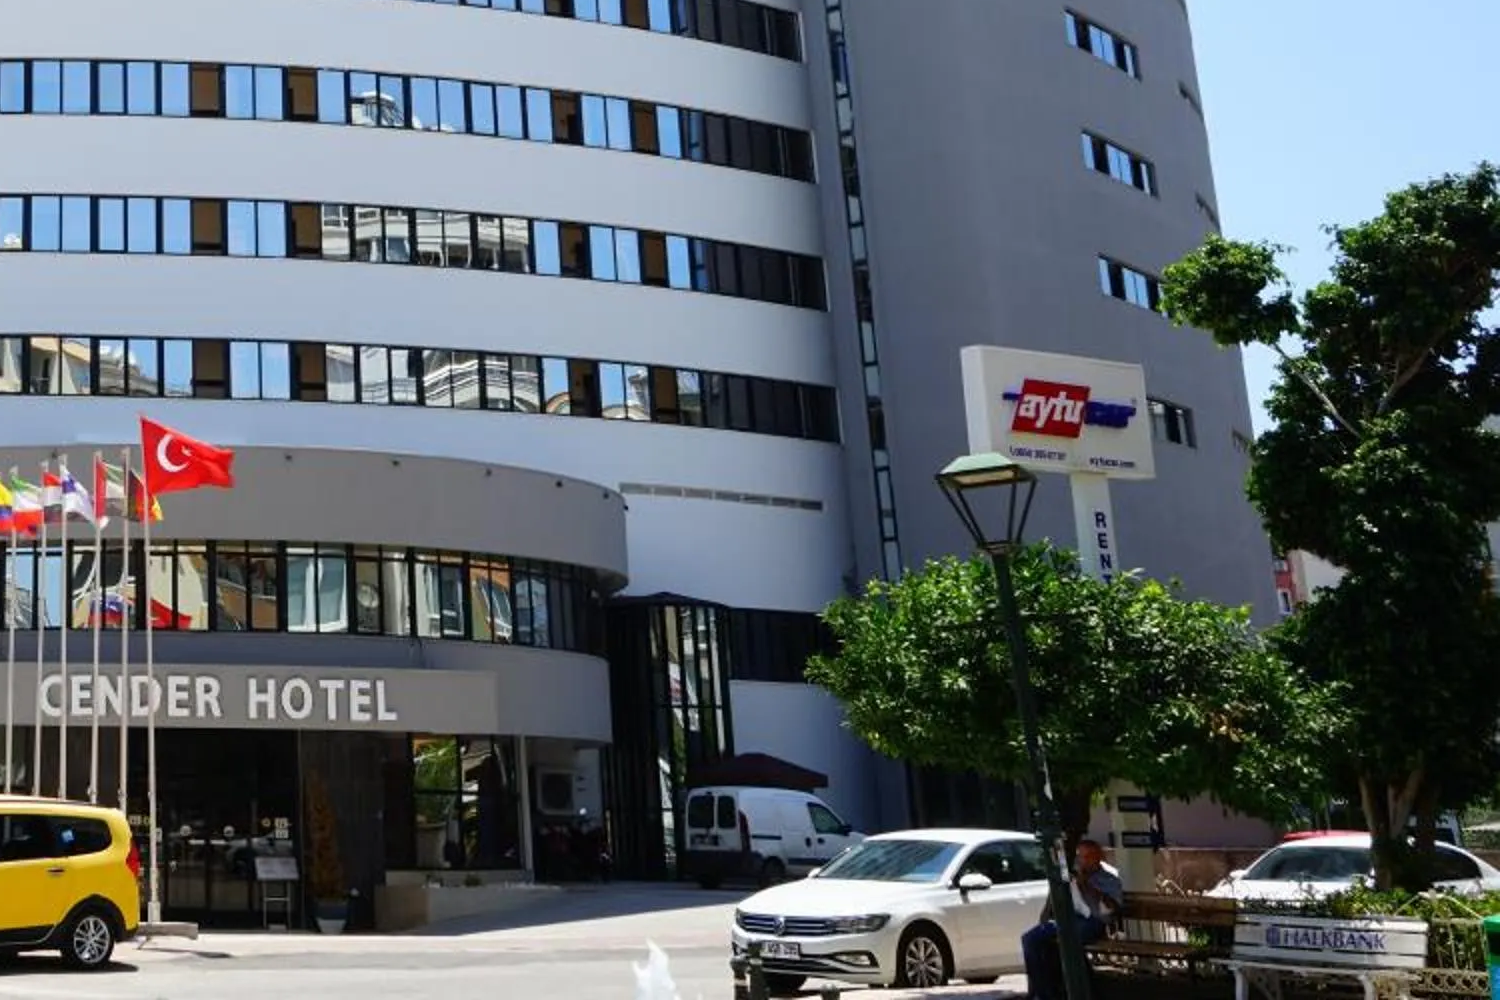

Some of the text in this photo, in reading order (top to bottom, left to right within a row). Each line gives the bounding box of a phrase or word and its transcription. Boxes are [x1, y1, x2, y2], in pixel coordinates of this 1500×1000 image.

[38, 674, 399, 722] CENDER HOTEL
[1284, 929, 1387, 949] HALKBANK
